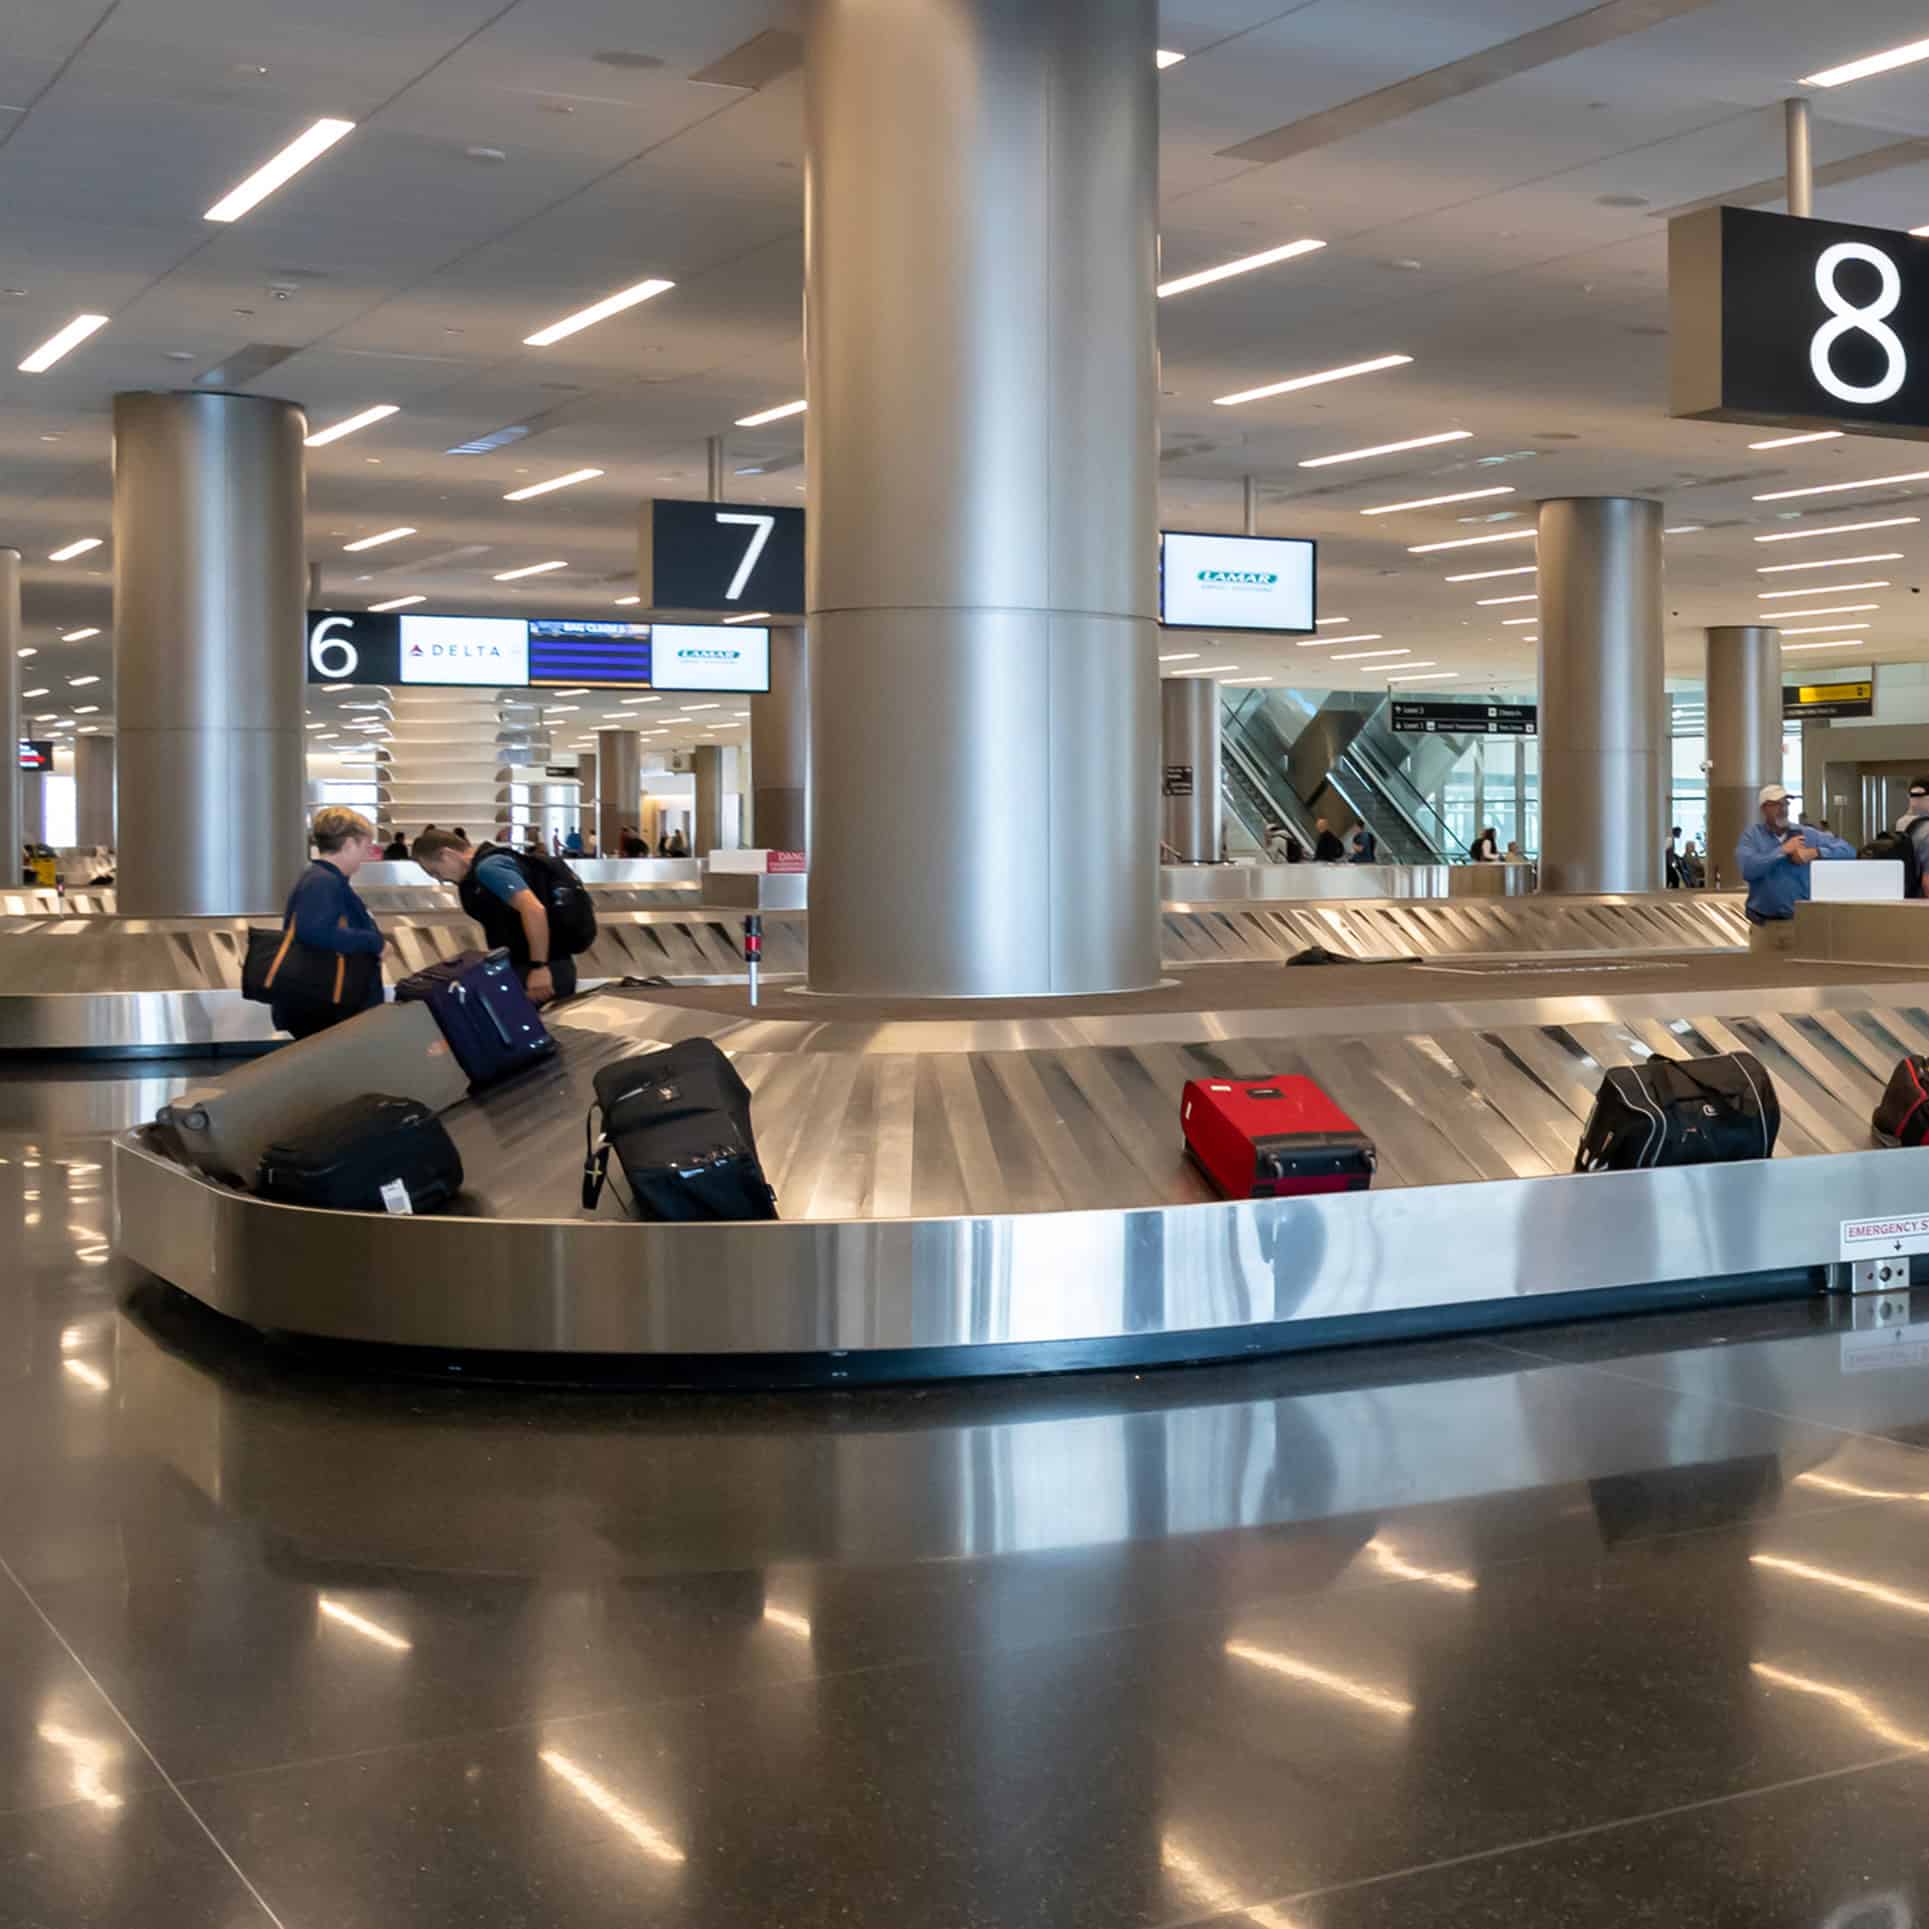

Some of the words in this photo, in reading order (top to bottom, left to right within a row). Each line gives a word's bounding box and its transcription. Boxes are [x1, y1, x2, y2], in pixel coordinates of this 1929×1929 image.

[1809, 241, 1907, 404] 8
[715, 512, 776, 600] 7
[1198, 570, 1275, 585] LAMAR
[309, 616, 359, 678] 6
[431, 643, 501, 657] DELTA
[1848, 1222, 1918, 1237] EMERGENCY
